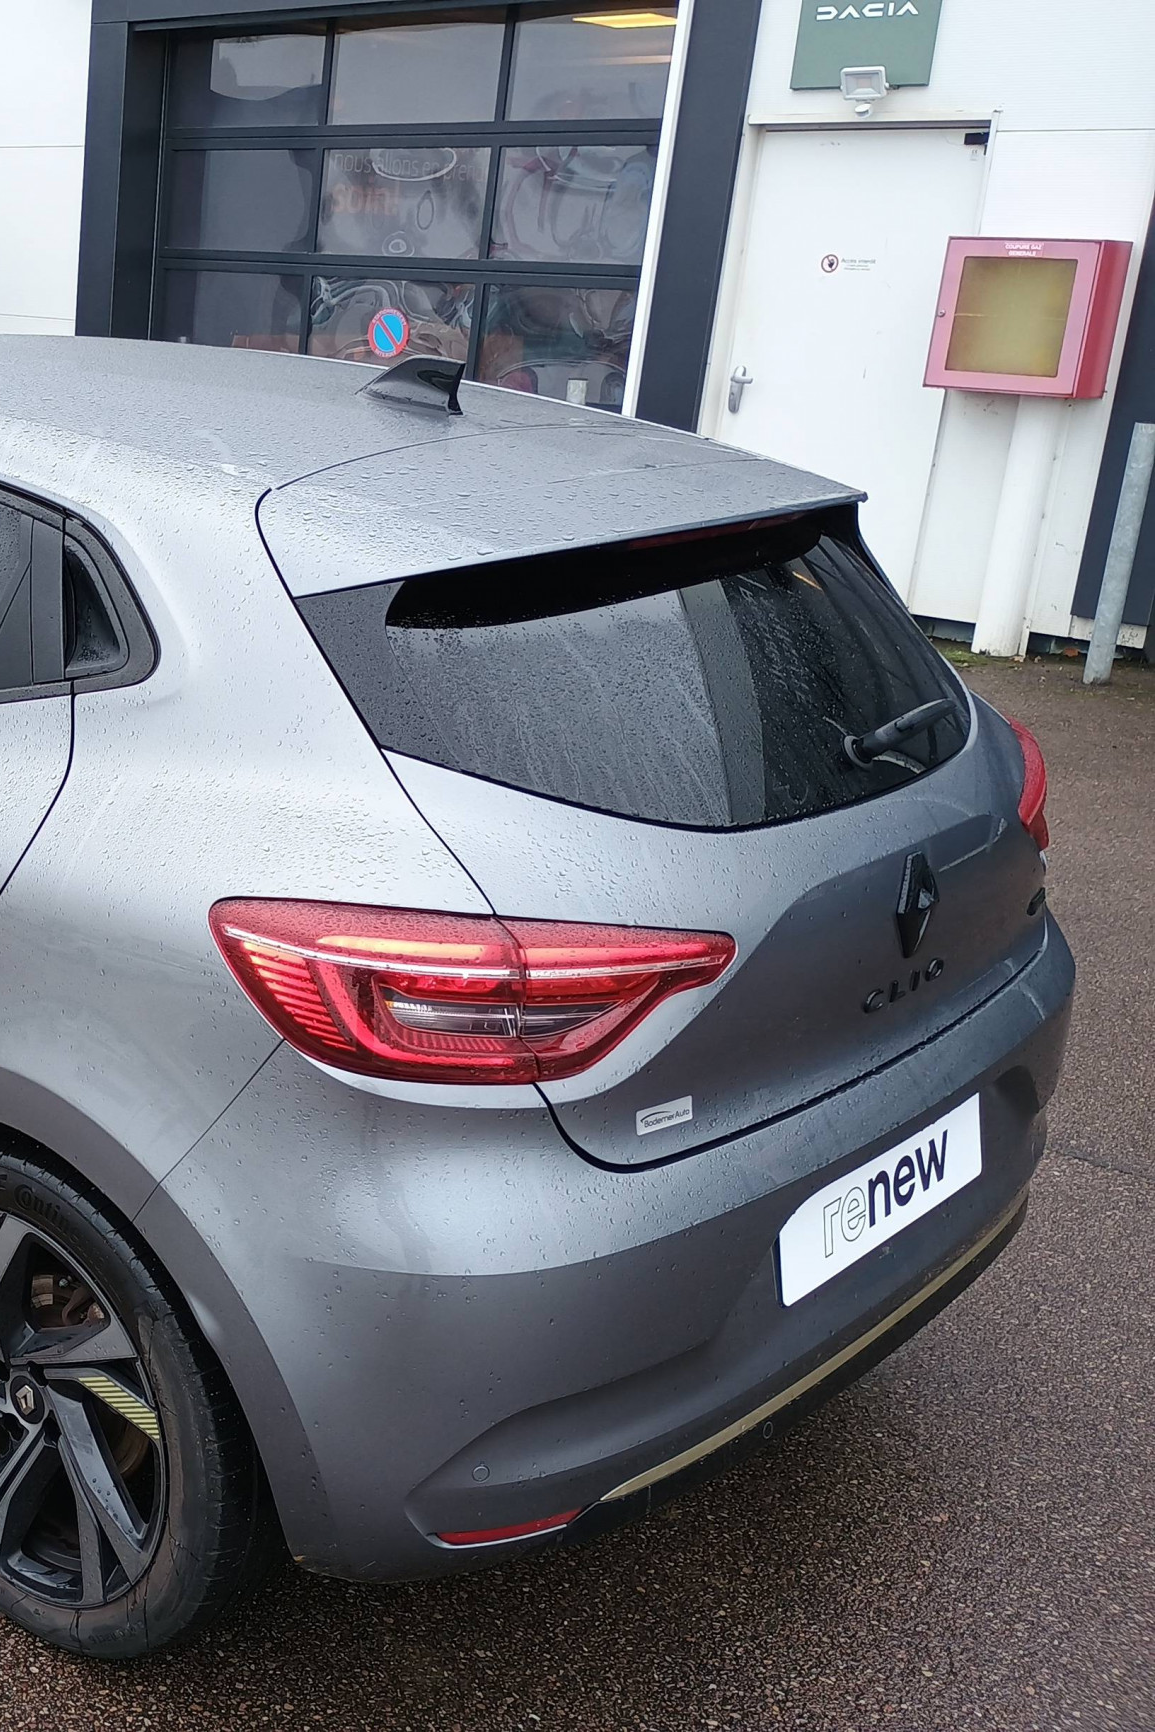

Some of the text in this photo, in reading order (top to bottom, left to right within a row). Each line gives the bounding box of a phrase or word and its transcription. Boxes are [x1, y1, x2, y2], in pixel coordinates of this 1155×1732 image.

[816, 1, 919, 21] DACIA
[334, 152, 372, 174] nous
[862, 957, 945, 1014] CLIO
[823, 1128, 949, 1259] renew
